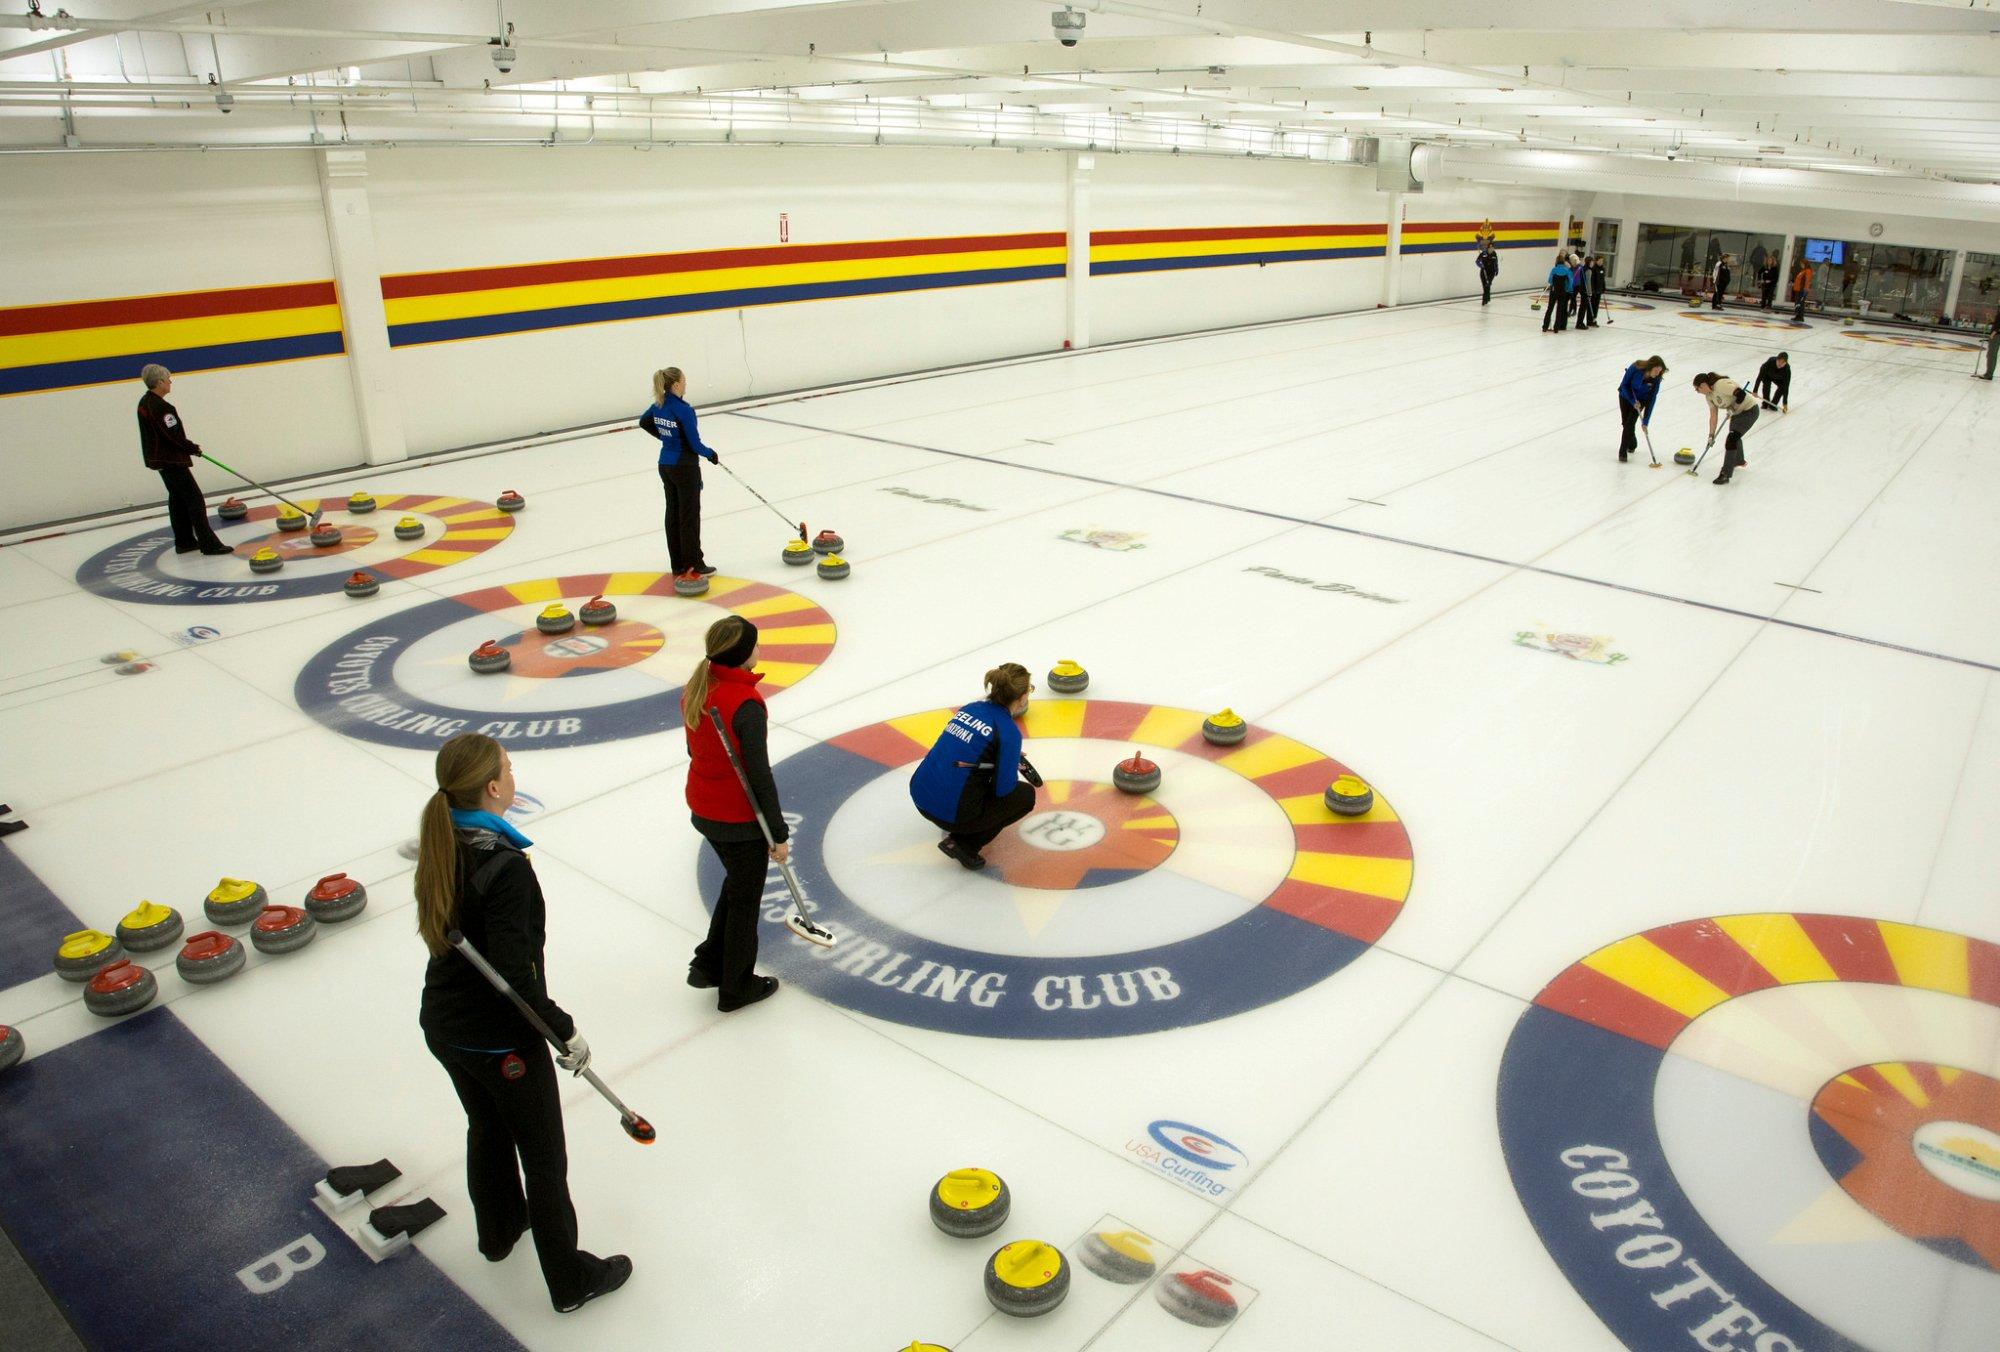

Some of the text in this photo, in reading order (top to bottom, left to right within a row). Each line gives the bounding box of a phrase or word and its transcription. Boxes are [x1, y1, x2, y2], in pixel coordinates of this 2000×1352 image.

[654, 417, 677, 428] EISTER
[197, 584, 280, 598] CLUB
[330, 636, 582, 739] COYOTES CURLING CLUB
[954, 711, 993, 737] EELING
[1031, 966, 1181, 1011] CLUB
[1125, 1139, 1160, 1163] USA
[1161, 1157, 1227, 1196] Curling
[235, 1233, 327, 1294] B
